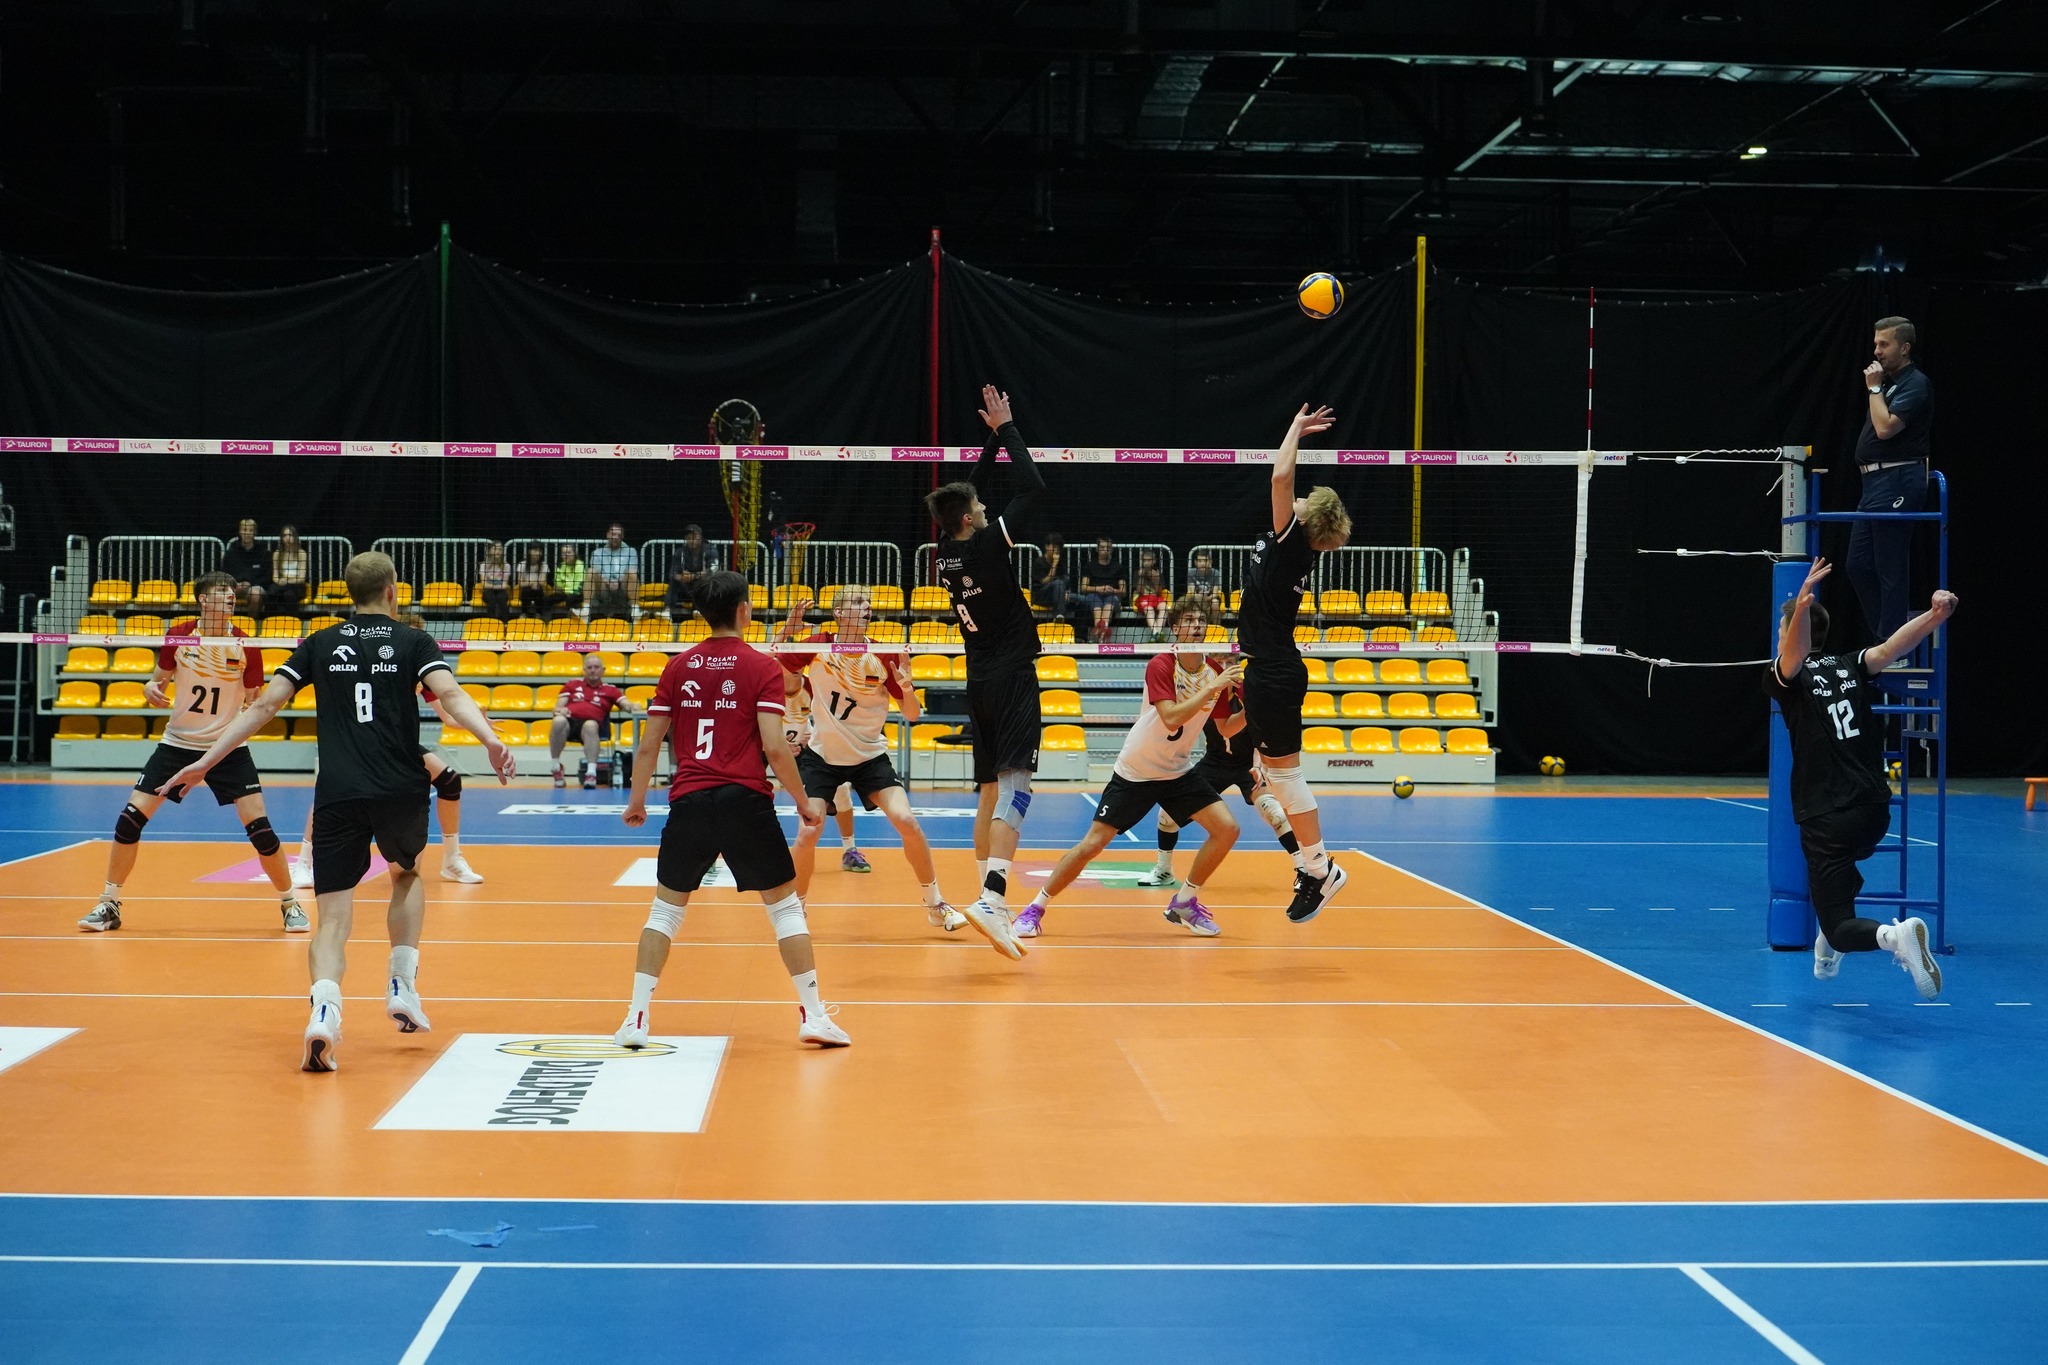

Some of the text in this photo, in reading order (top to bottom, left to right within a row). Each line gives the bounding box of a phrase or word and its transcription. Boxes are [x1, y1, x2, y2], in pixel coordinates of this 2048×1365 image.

[238, 443, 269, 451] TAURON
[460, 446, 491, 454] TAURON
[908, 450, 940, 458] TAURON
[977, 450, 1008, 458] TON
[962, 587, 983, 600] plus
[329, 662, 398, 675] ORLEN plus
[1840, 680, 1857, 693] plus
[188, 685, 220, 715] 21
[354, 682, 374, 723] 8
[715, 698, 737, 711] plus
[829, 690, 858, 720] 17
[1827, 699, 1860, 740] 12
[695, 718, 715, 760] 5
[1328, 759, 1374, 767] PESMENPOL
[1099, 805, 1109, 817] 5
[487, 1060, 604, 1125] DALDEHOG
